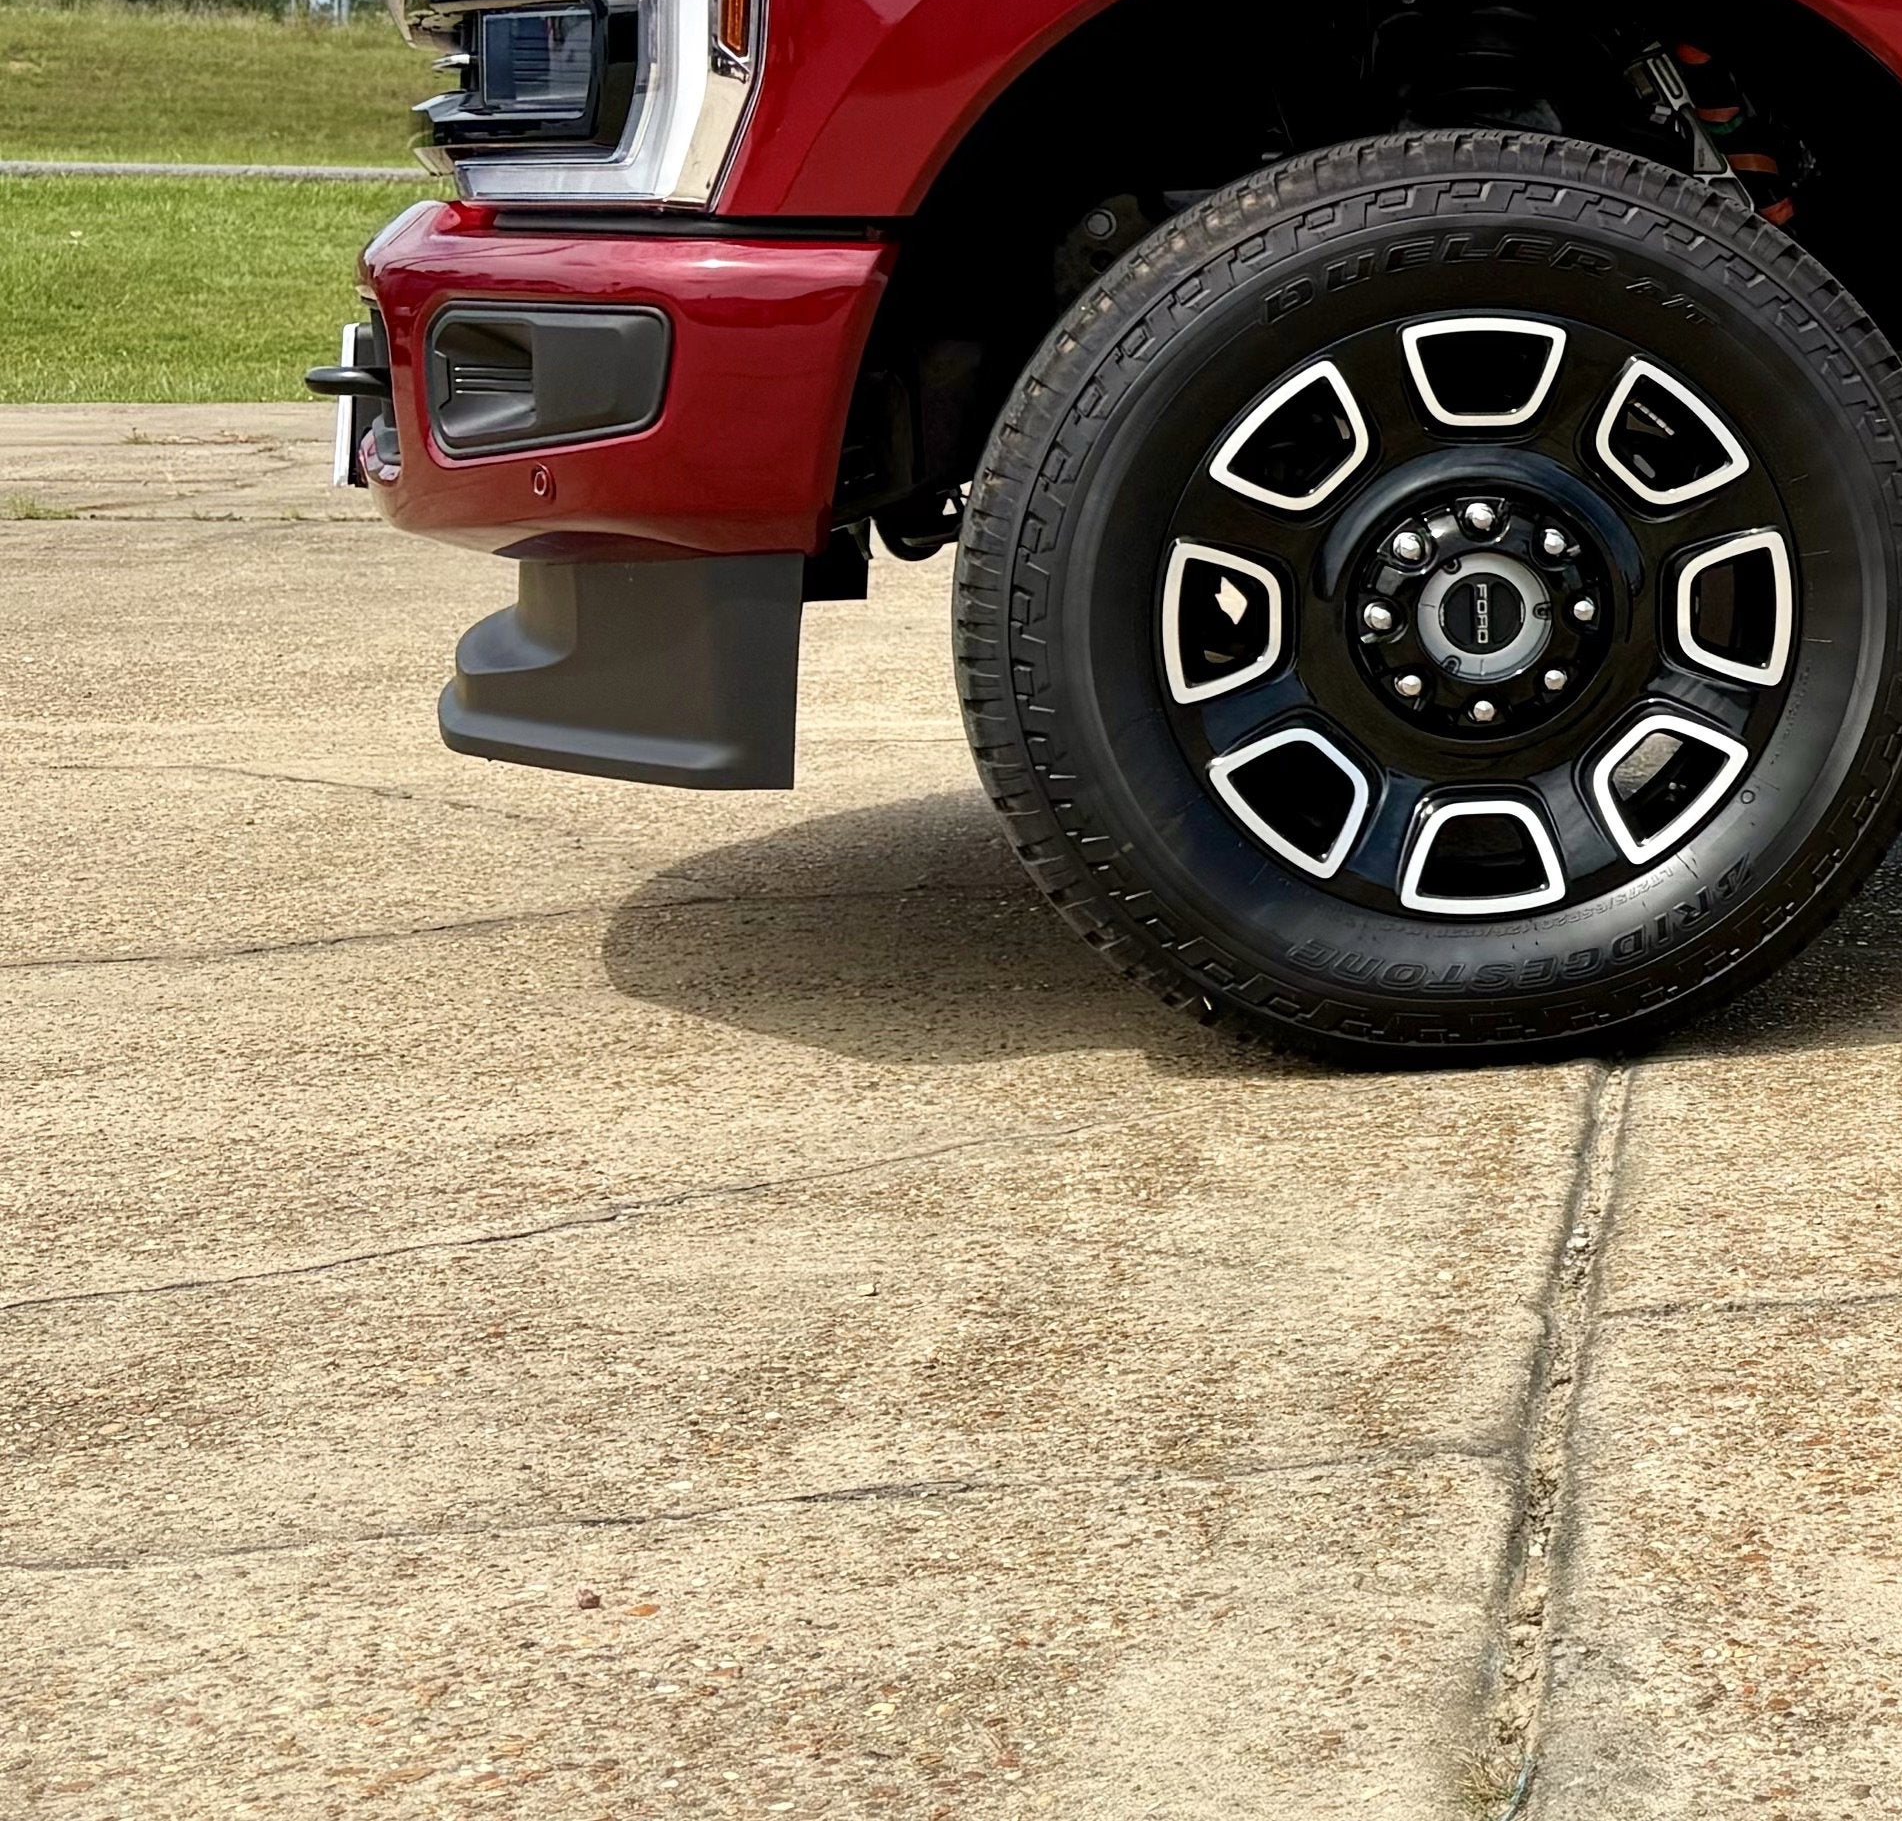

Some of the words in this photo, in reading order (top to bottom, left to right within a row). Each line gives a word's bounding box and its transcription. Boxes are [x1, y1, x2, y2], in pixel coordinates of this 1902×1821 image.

[1263, 233, 1619, 325] DUELER
[1477, 583, 1489, 644] FORD
[1286, 850, 1756, 993] BRIDGESTONE
